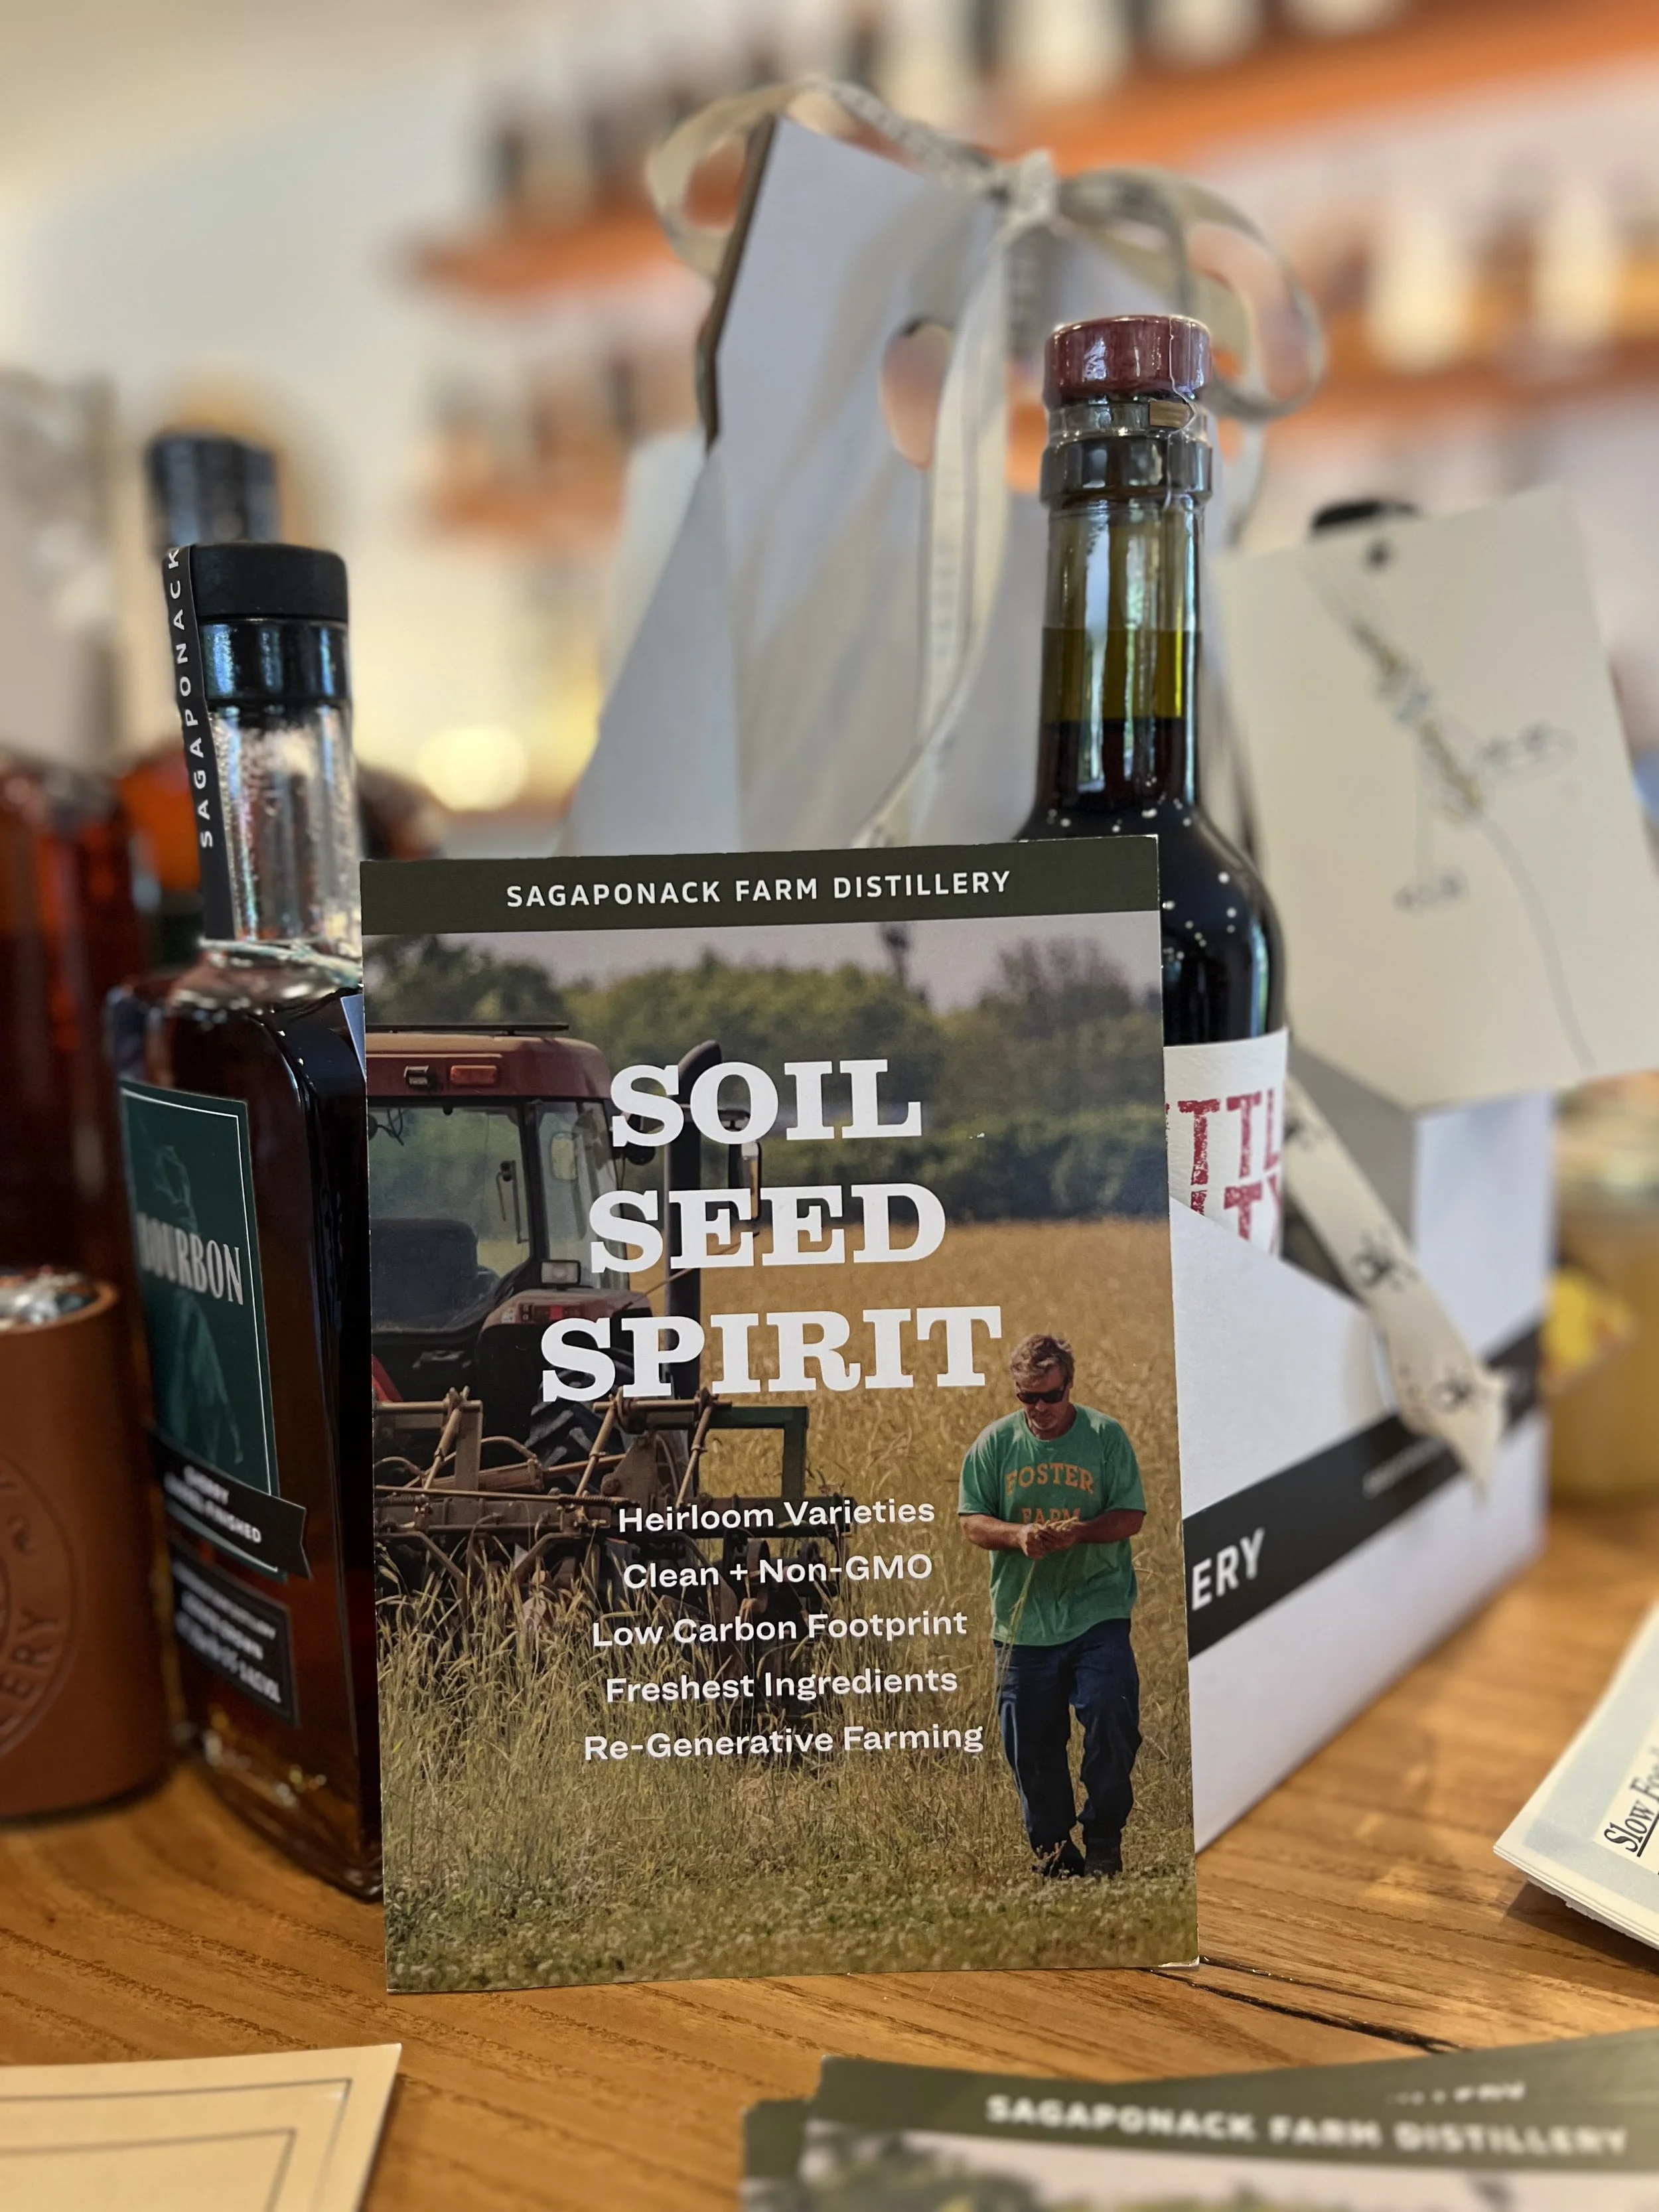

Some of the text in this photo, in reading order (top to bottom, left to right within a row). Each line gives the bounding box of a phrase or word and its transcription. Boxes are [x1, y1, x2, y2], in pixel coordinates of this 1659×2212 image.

[168, 548, 213, 849] SAGAPONACK
[506, 870, 1011, 907] SAGAPONACK FARM DISTILLERY
[610, 1059, 922, 1147] SOIL
[589, 1183, 946, 1273] SEED
[541, 1305, 1002, 1402] SPIRIT
[1005, 1463, 1094, 1496] FOSTER
[619, 1499, 935, 1532] Heirloom Varieties
[623, 1554, 933, 1589] Clean + Non-GMO
[593, 1611, 968, 1647] Low Carbon Footprint
[607, 1668, 958, 1703] Freshest Ingredients
[585, 1724, 983, 1761] Re-Generative Farming
[1604, 1799, 1655, 1852] Slow
[985, 2093, 1628, 2156] SAGAPONACK FARM DISTILLERY
